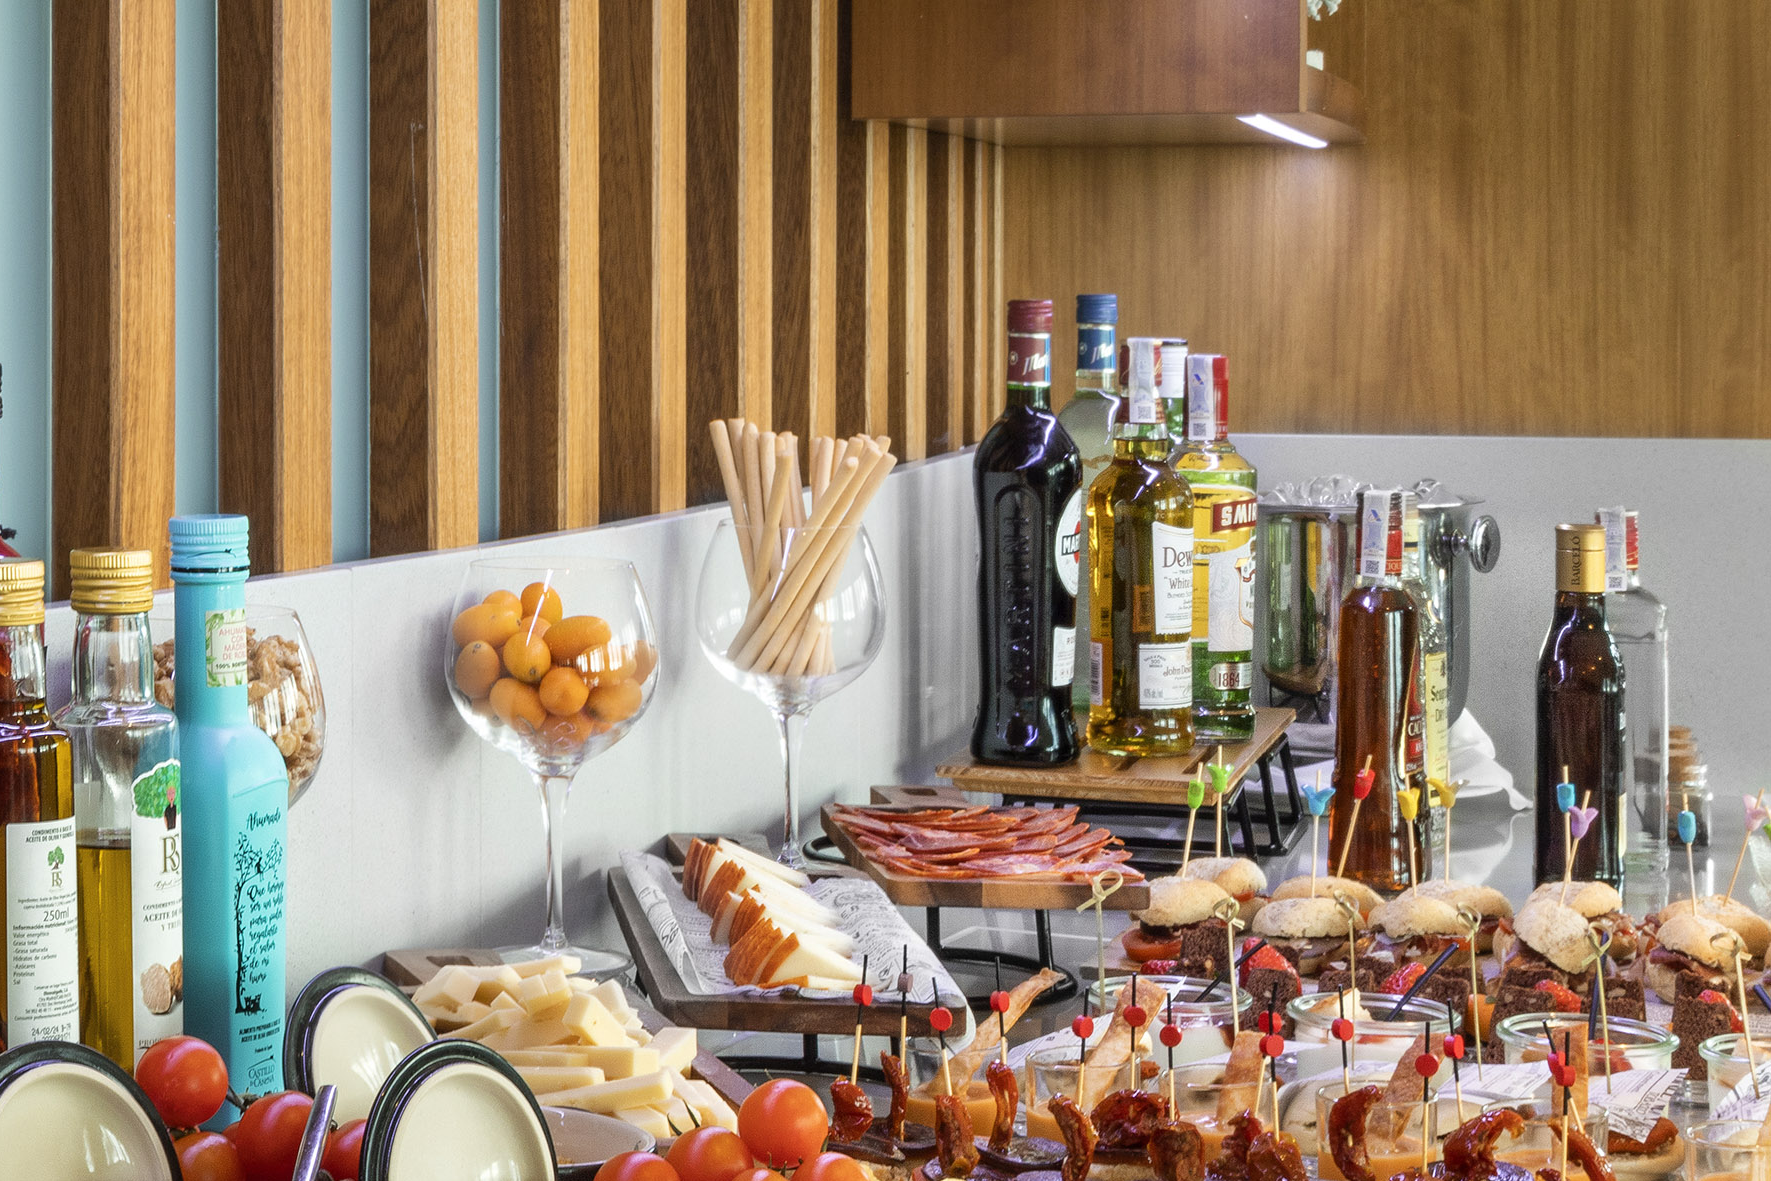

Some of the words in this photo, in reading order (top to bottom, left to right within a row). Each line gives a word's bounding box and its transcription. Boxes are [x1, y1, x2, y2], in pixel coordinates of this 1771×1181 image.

[1218, 672, 1240, 688] 1864
[44, 908, 70, 922] 250ml
[142, 911, 170, 923] ACEITE
[248, 1064, 275, 1080] CASTILLO
